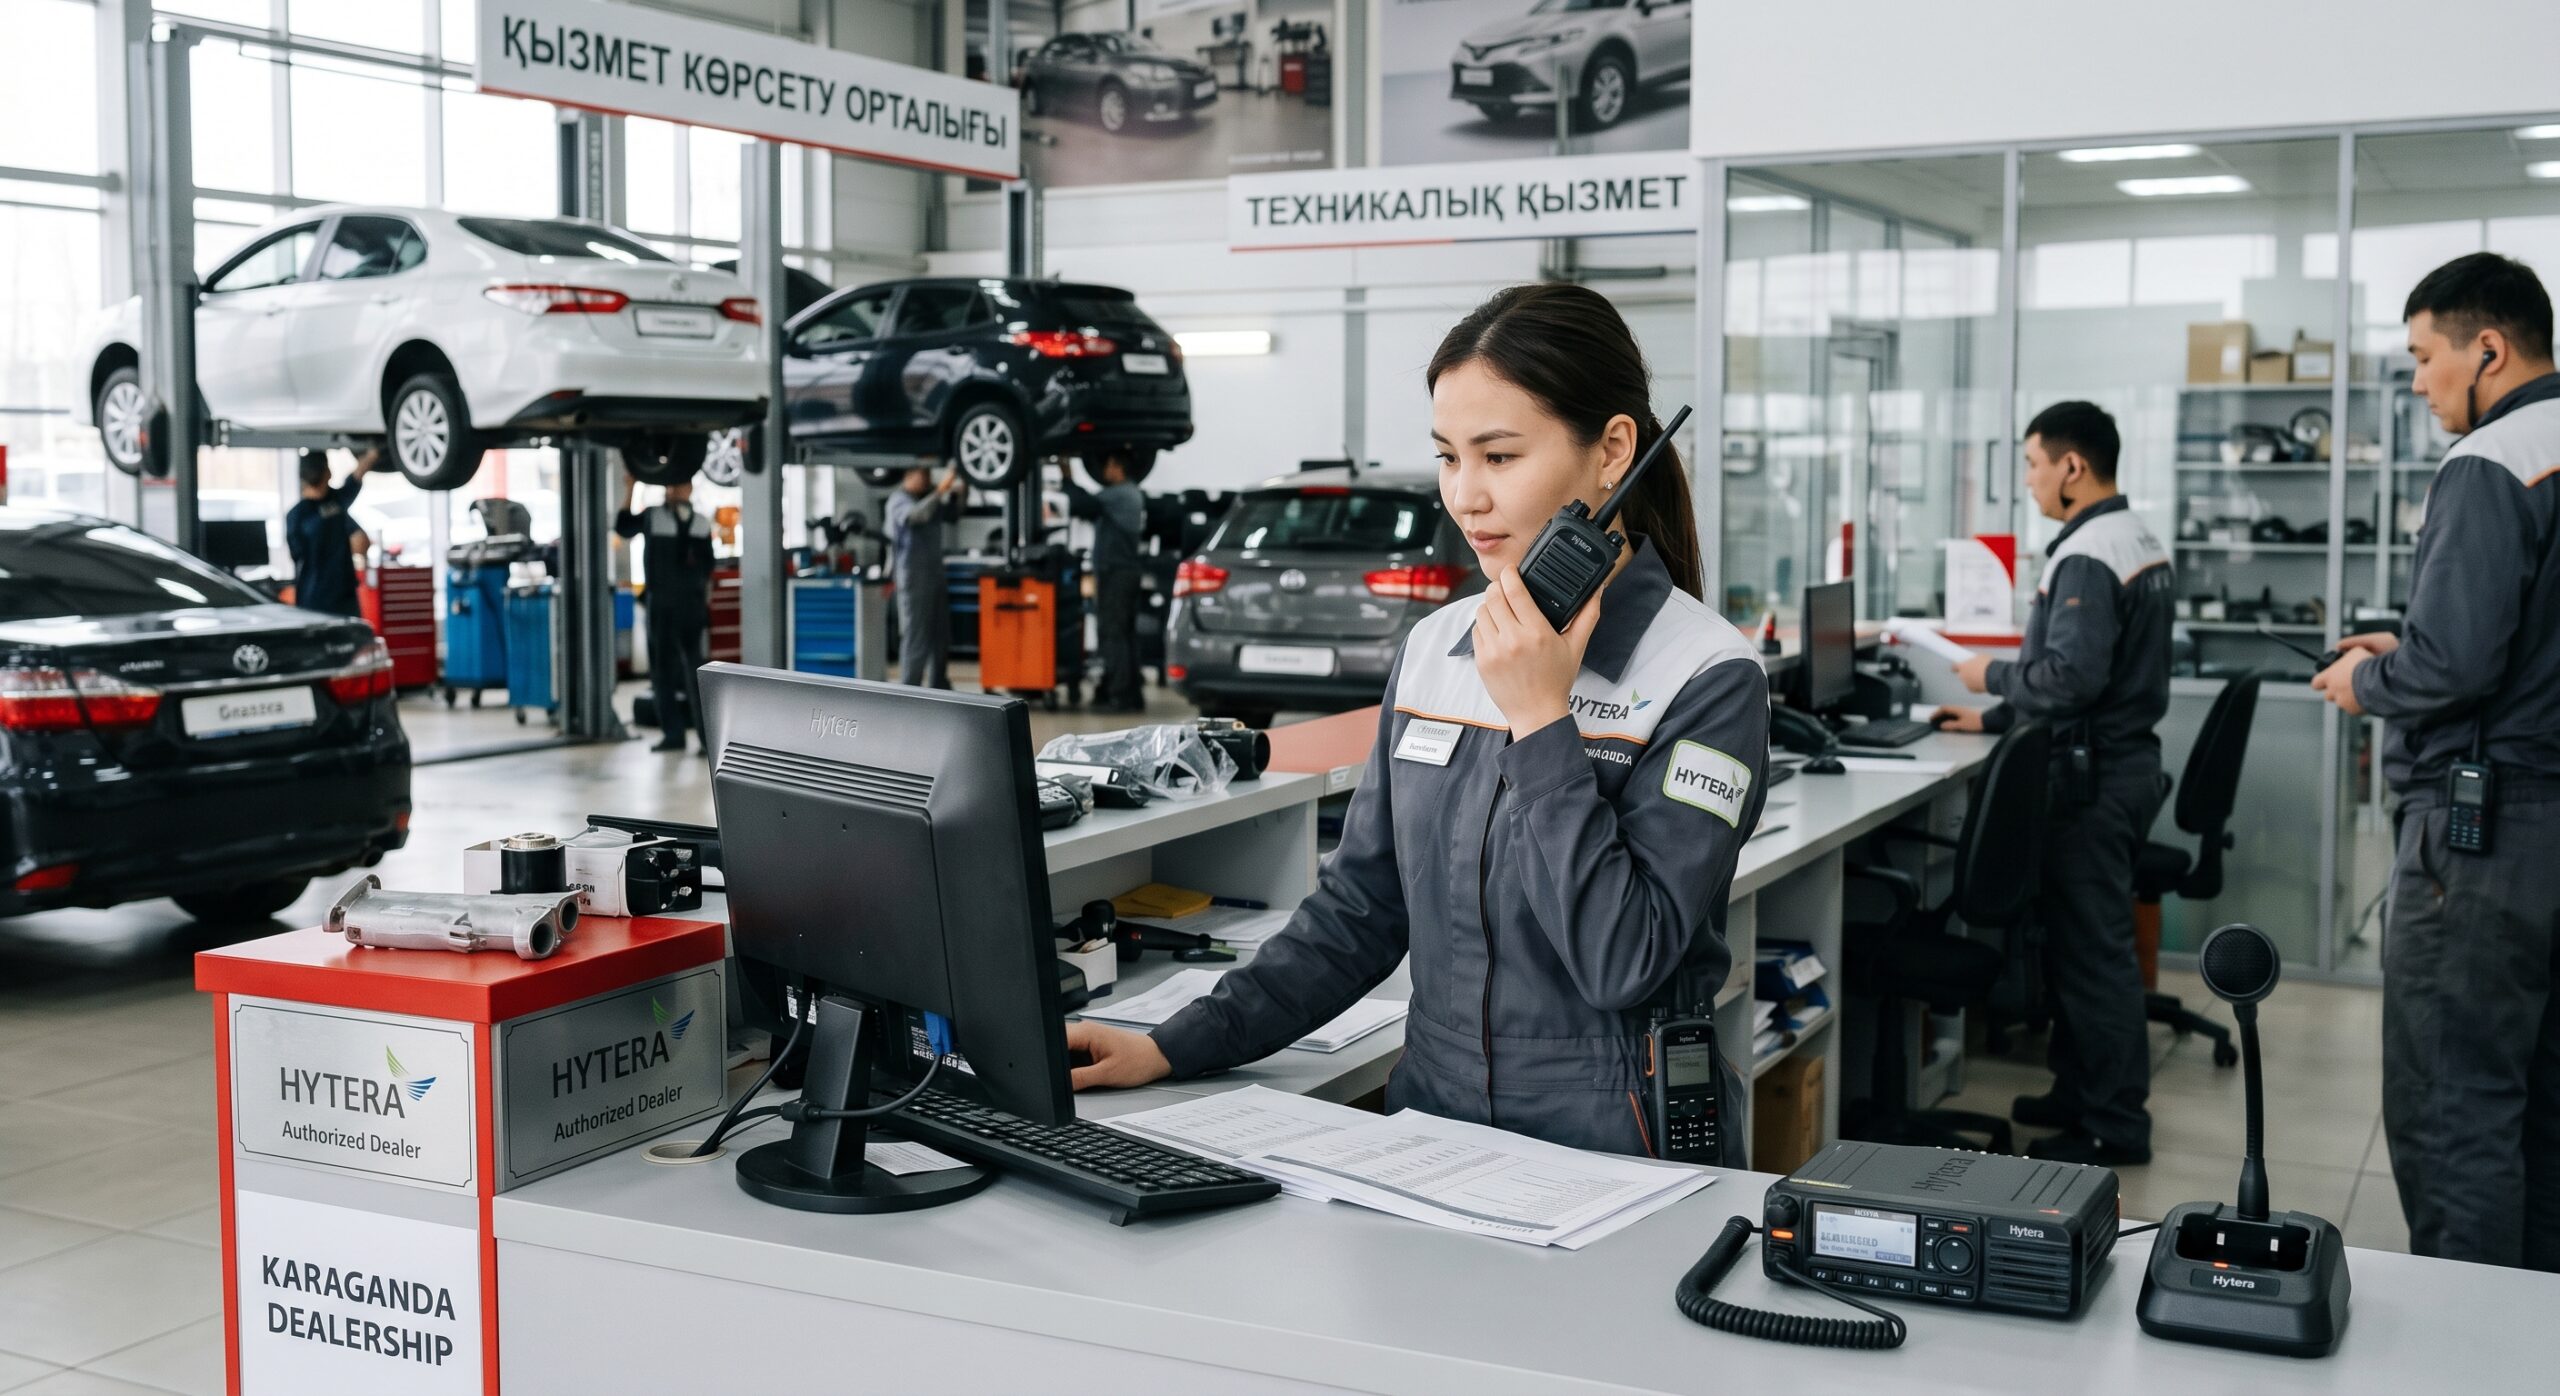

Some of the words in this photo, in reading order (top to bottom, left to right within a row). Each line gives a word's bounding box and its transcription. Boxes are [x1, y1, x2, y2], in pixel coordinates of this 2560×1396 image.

[503, 15, 671, 87] ҚЫЗМЕТ
[683, 52, 837, 116] КӨРСЕТУ
[846, 86, 1008, 150] ОРТАЛЫҒЫ
[1246, 185, 1504, 227] ТЕХНИКАЛЫҚ
[1518, 175, 1688, 221] ҚЫЗМЕТ
[1674, 766, 1735, 804] HYTERA
[552, 1030, 670, 1099] HYTERA
[280, 1066, 406, 1119] HYTERA
[554, 1097, 634, 1143] Authorized
[638, 1086, 683, 1113] Dealer
[282, 1120, 365, 1151] Authorized
[370, 1134, 421, 1159] Dealer
[2009, 1224, 2045, 1239] Hytera
[262, 1254, 456, 1321] KARAGANDA
[2212, 1274, 2256, 1289] Hytera
[268, 1301, 454, 1367] DEALERSHIP
